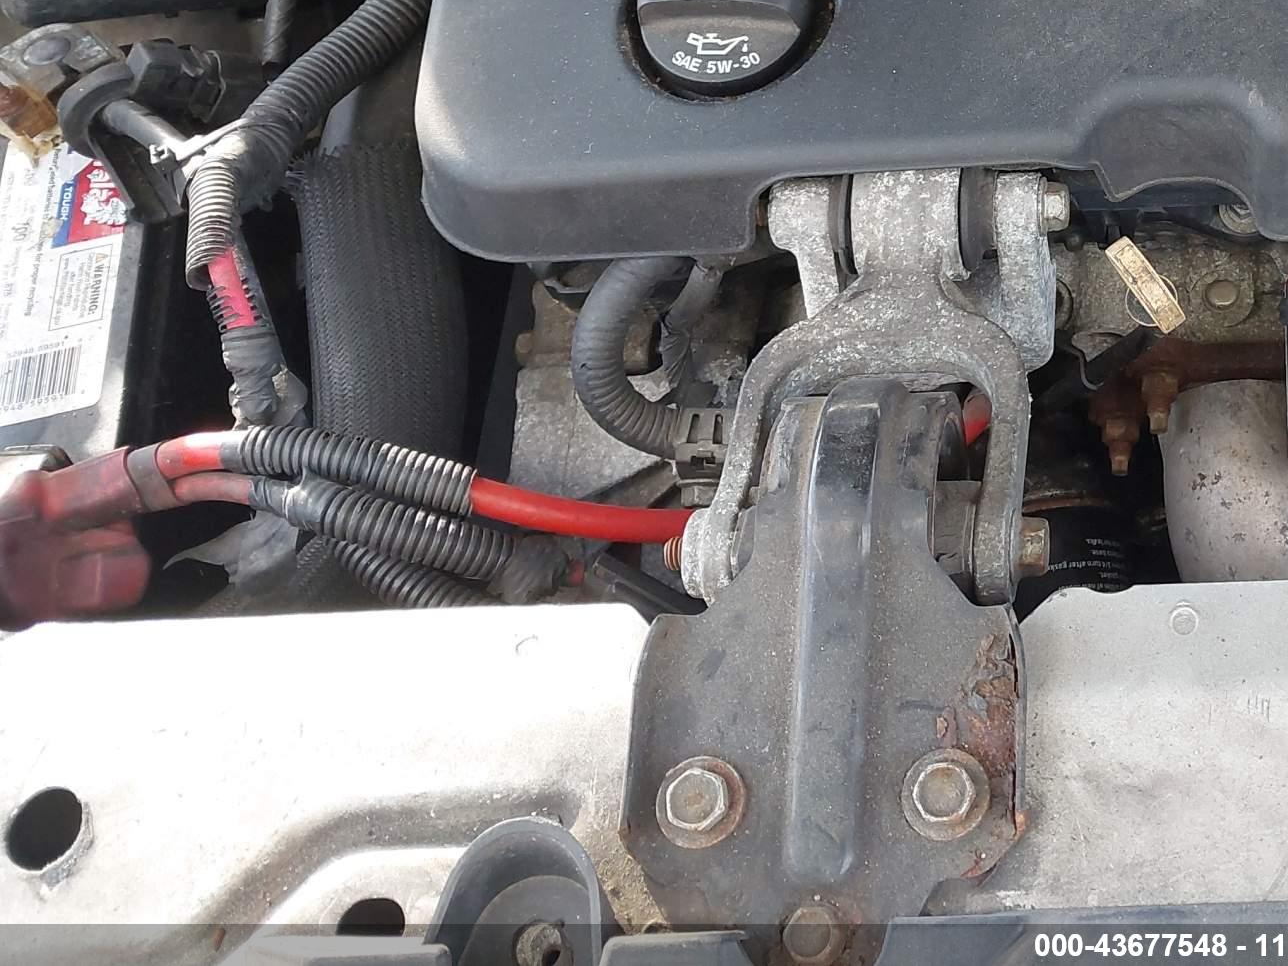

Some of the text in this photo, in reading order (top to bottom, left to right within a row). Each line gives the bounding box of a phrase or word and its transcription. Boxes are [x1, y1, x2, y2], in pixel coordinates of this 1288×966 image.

[671, 51, 761, 74] SAE 5W-30
[60, 186, 73, 221] TOUGH
[88, 264, 104, 315] WARNING:
